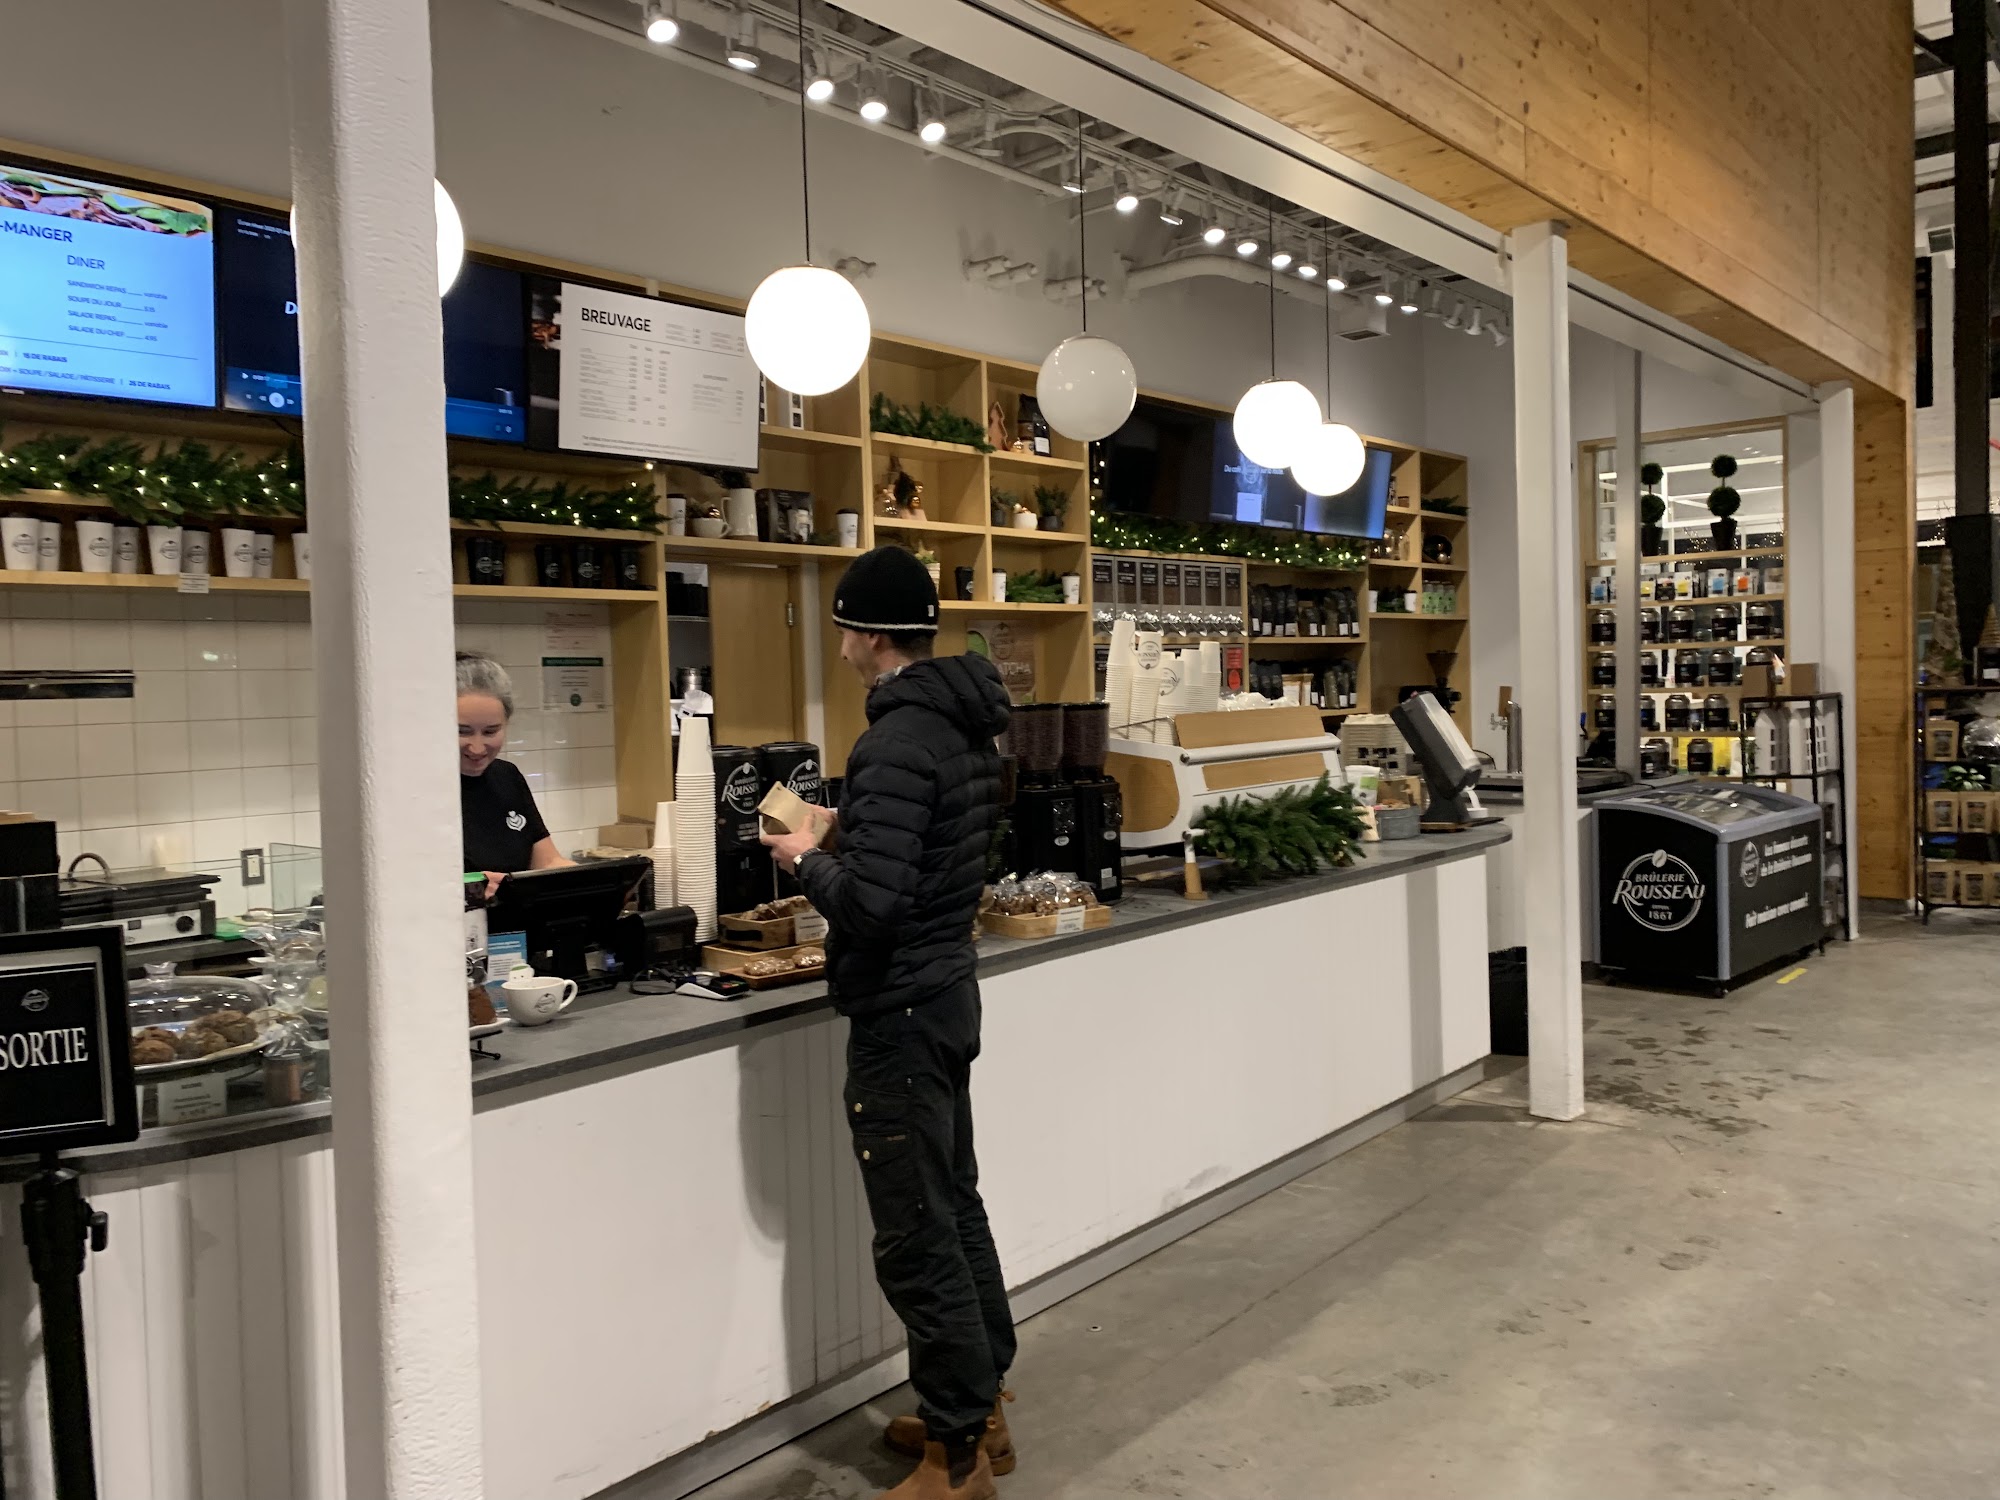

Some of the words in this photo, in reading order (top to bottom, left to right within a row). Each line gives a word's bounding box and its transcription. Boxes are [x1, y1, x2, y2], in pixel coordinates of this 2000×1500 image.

[67, 254, 105, 270] DINER
[67, 295, 90, 304] SOUPE
[104, 300, 122, 308] JOUR
[67, 310, 94, 320] SALADE
[581, 307, 652, 332] BREUVAGE
[68, 325, 95, 334] SALADE
[42, 354, 68, 363] RABAIS
[148, 382, 171, 390] RABAIS
[993, 662, 1032, 675] ATCHA
[1612, 879, 1706, 907] ROUSSEAU
[1648, 910, 1673, 921] 1867
[0, 1026, 89, 1071] SORTIE
